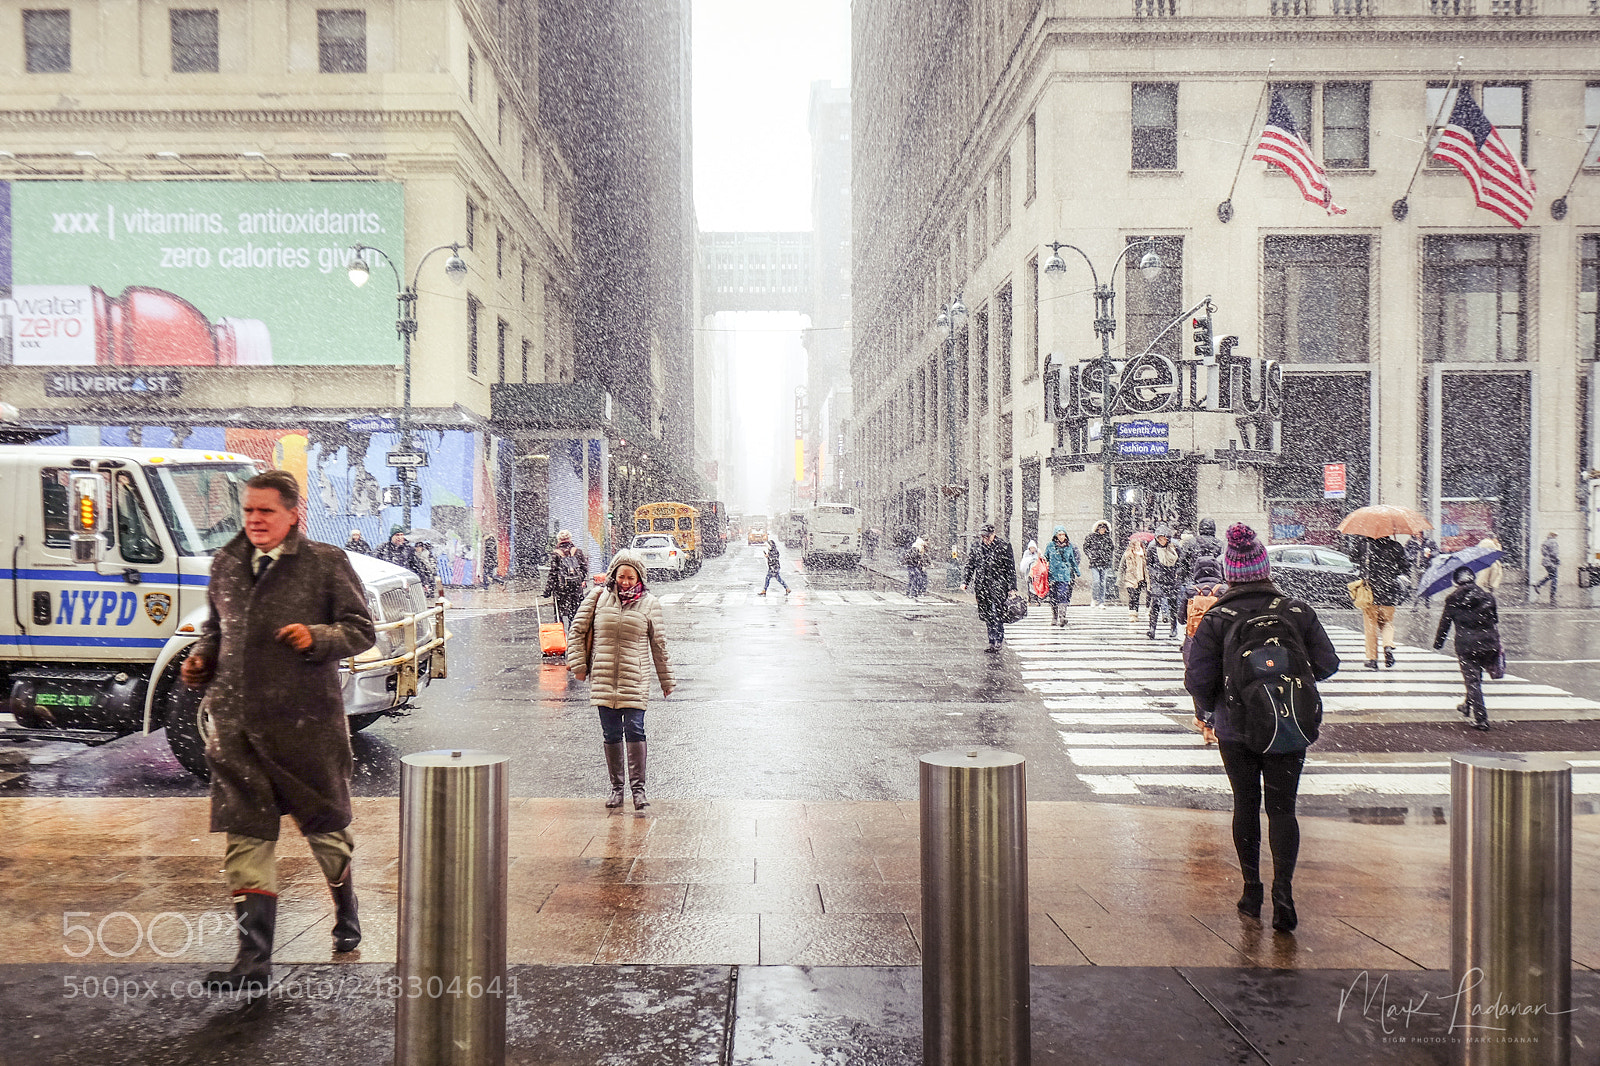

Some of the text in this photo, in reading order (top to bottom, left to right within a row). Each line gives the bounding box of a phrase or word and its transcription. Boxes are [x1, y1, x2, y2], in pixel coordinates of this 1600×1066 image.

[52, 211, 101, 234] xxx
[123, 208, 229, 234] vitamins.
[238, 208, 386, 234] antioxidants.
[160, 241, 386, 273] zero calories givn.
[15, 296, 83, 316] water
[19, 317, 83, 338] zero
[53, 376, 170, 392] SILVERCAST
[349, 421, 396, 430] Seventh Ave
[1119, 425, 1167, 435] Seventh Ave
[1120, 443, 1165, 453] Fashion Ave
[55, 590, 138, 626] NYPD
